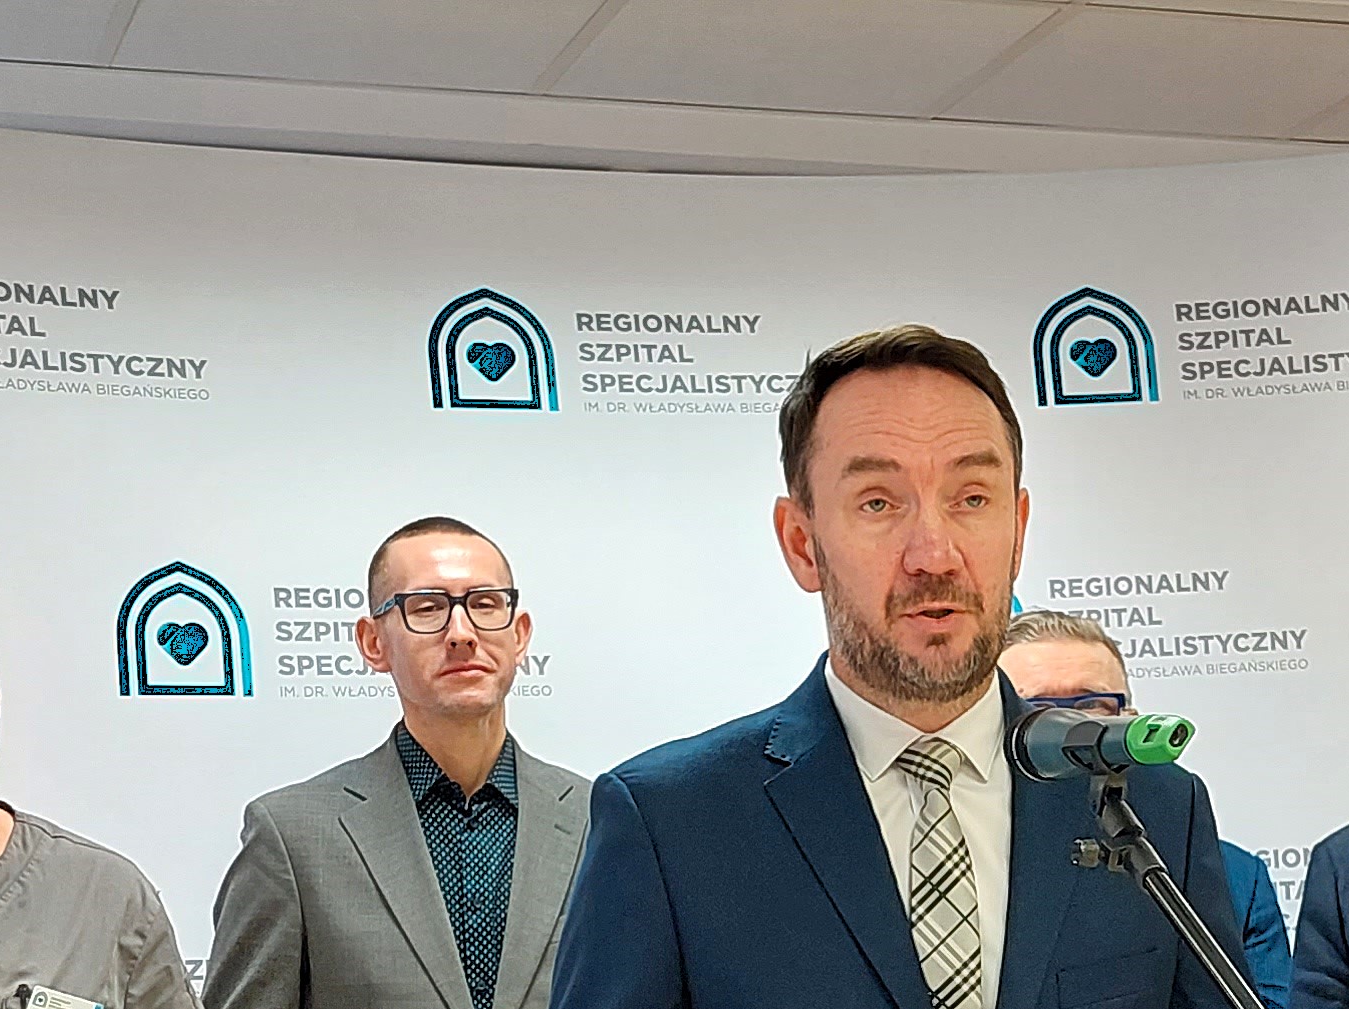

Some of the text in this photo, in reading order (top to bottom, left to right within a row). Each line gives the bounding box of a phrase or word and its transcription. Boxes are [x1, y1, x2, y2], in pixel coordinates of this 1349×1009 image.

[576, 313, 761, 334] REGIONALNY
[1178, 326, 1292, 351] SZPITAL
[579, 342, 694, 363] SZPITAL
[96, 383, 210, 401] BIEGAŃSKIEGO
[1232, 382, 1333, 398] WŁADYSŁAWA
[634, 402, 736, 414] WŁADYSŁAWA
[1049, 570, 1229, 600] REGIONALNY
[273, 588, 364, 609] REGIO
[275, 621, 356, 642] SZPIT
[1115, 629, 1308, 659] JALISTYCZNY
[1206, 658, 1309, 676] BIEGAŃSKIEGO
[279, 685, 395, 698] IM. DR. WŁADYS
